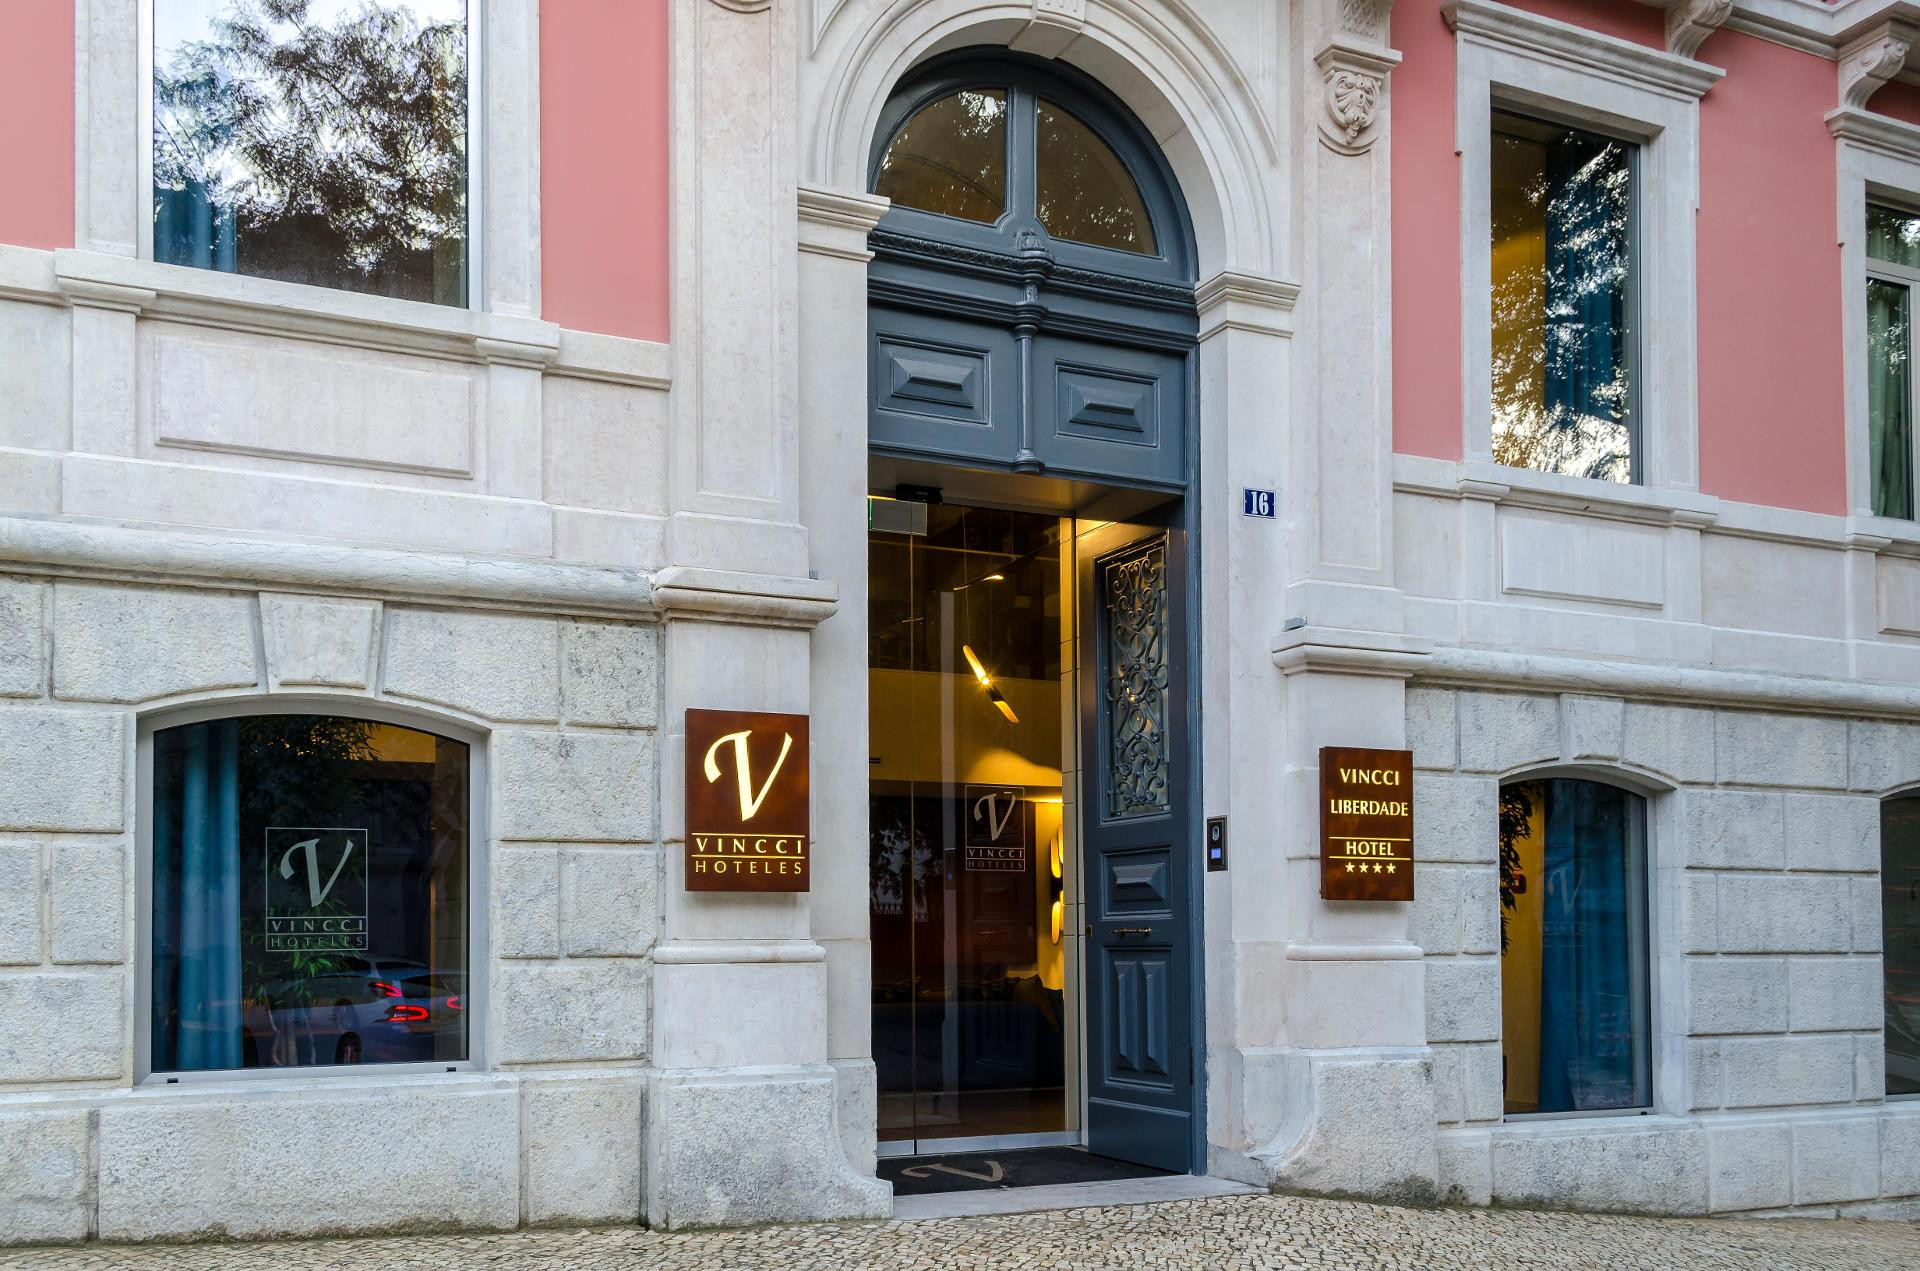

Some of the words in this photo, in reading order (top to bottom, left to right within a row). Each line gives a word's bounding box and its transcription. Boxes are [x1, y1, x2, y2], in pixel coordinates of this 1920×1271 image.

[1251, 491, 1269, 515] 16
[704, 729, 793, 822] V
[1340, 768, 1400, 786] VINCCI
[1330, 799, 1409, 817] LIBERDADE
[973, 793, 1016, 841] V
[696, 838, 802, 854] VINCCI
[968, 849, 1022, 858] VINCCI
[1346, 841, 1395, 857] HOTEL
[695, 860, 802, 875] HOTELES
[968, 860, 1023, 869] HOTELES
[280, 838, 354, 908] V
[271, 920, 363, 932] VINCCI
[271, 936, 363, 947] HOTELES
